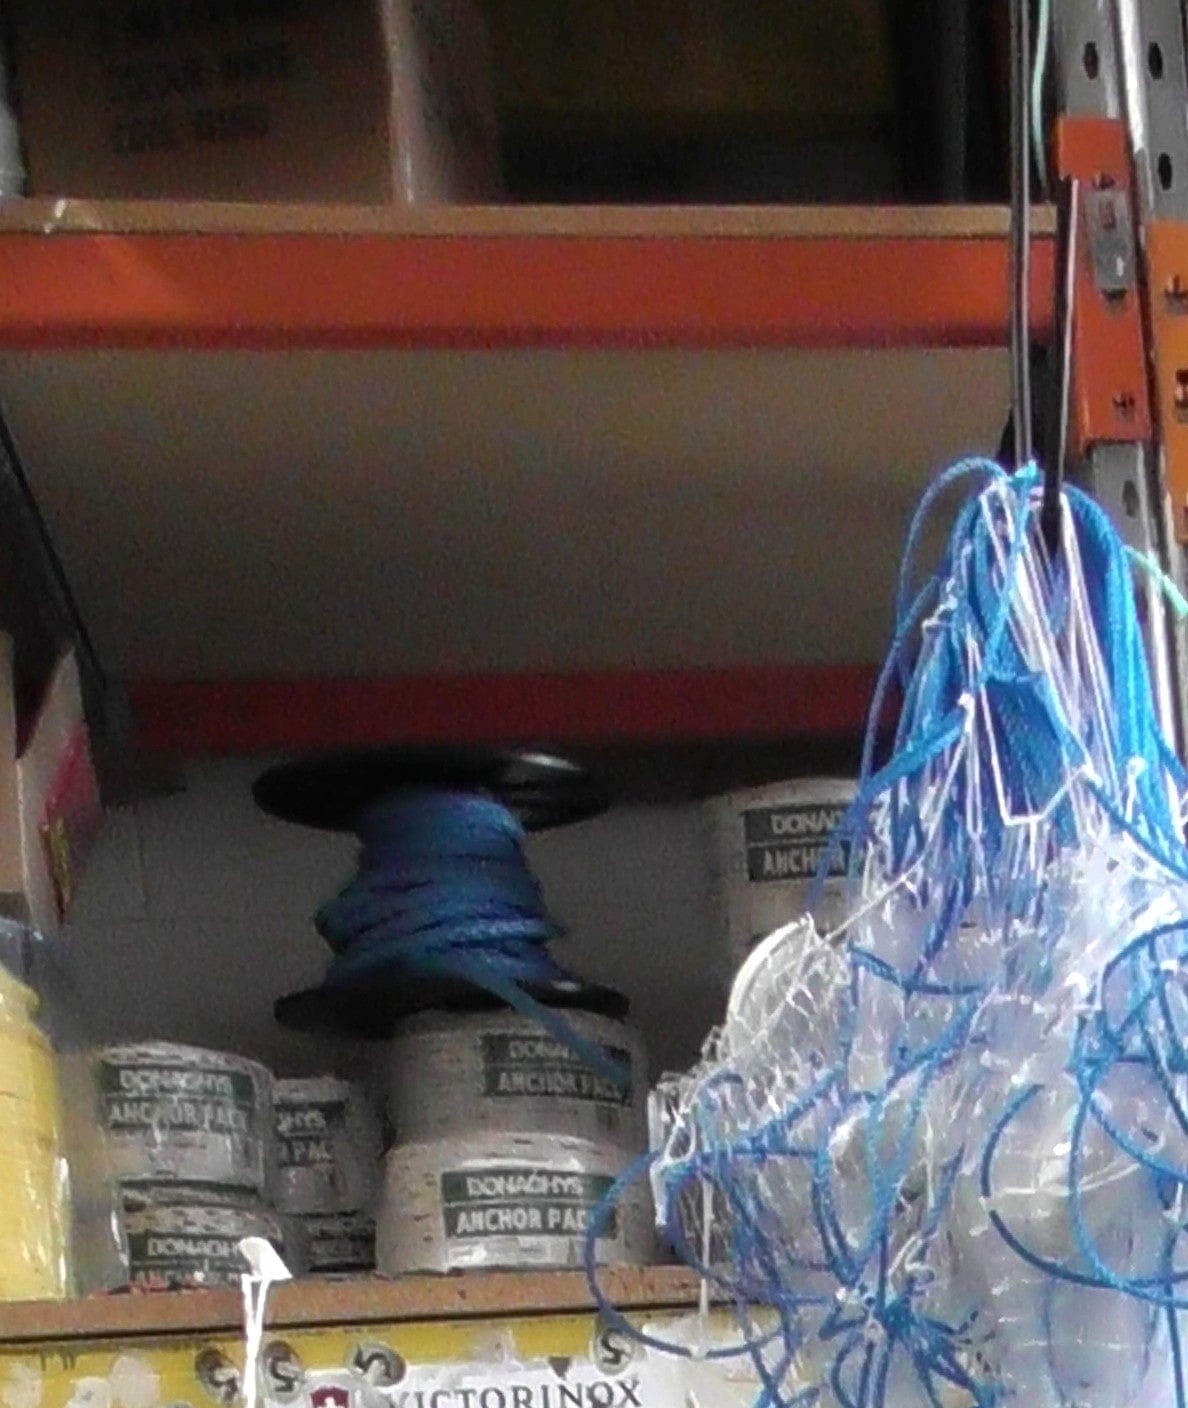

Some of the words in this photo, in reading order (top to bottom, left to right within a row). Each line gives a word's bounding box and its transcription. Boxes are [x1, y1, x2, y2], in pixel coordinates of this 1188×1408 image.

[770, 808, 844, 834] DONA
[466, 1174, 584, 1197] DONAGHYS
[456, 1207, 542, 1234] ANCHOR
[548, 1207, 594, 1231] PAC
[147, 1238, 240, 1257] DONAGH
